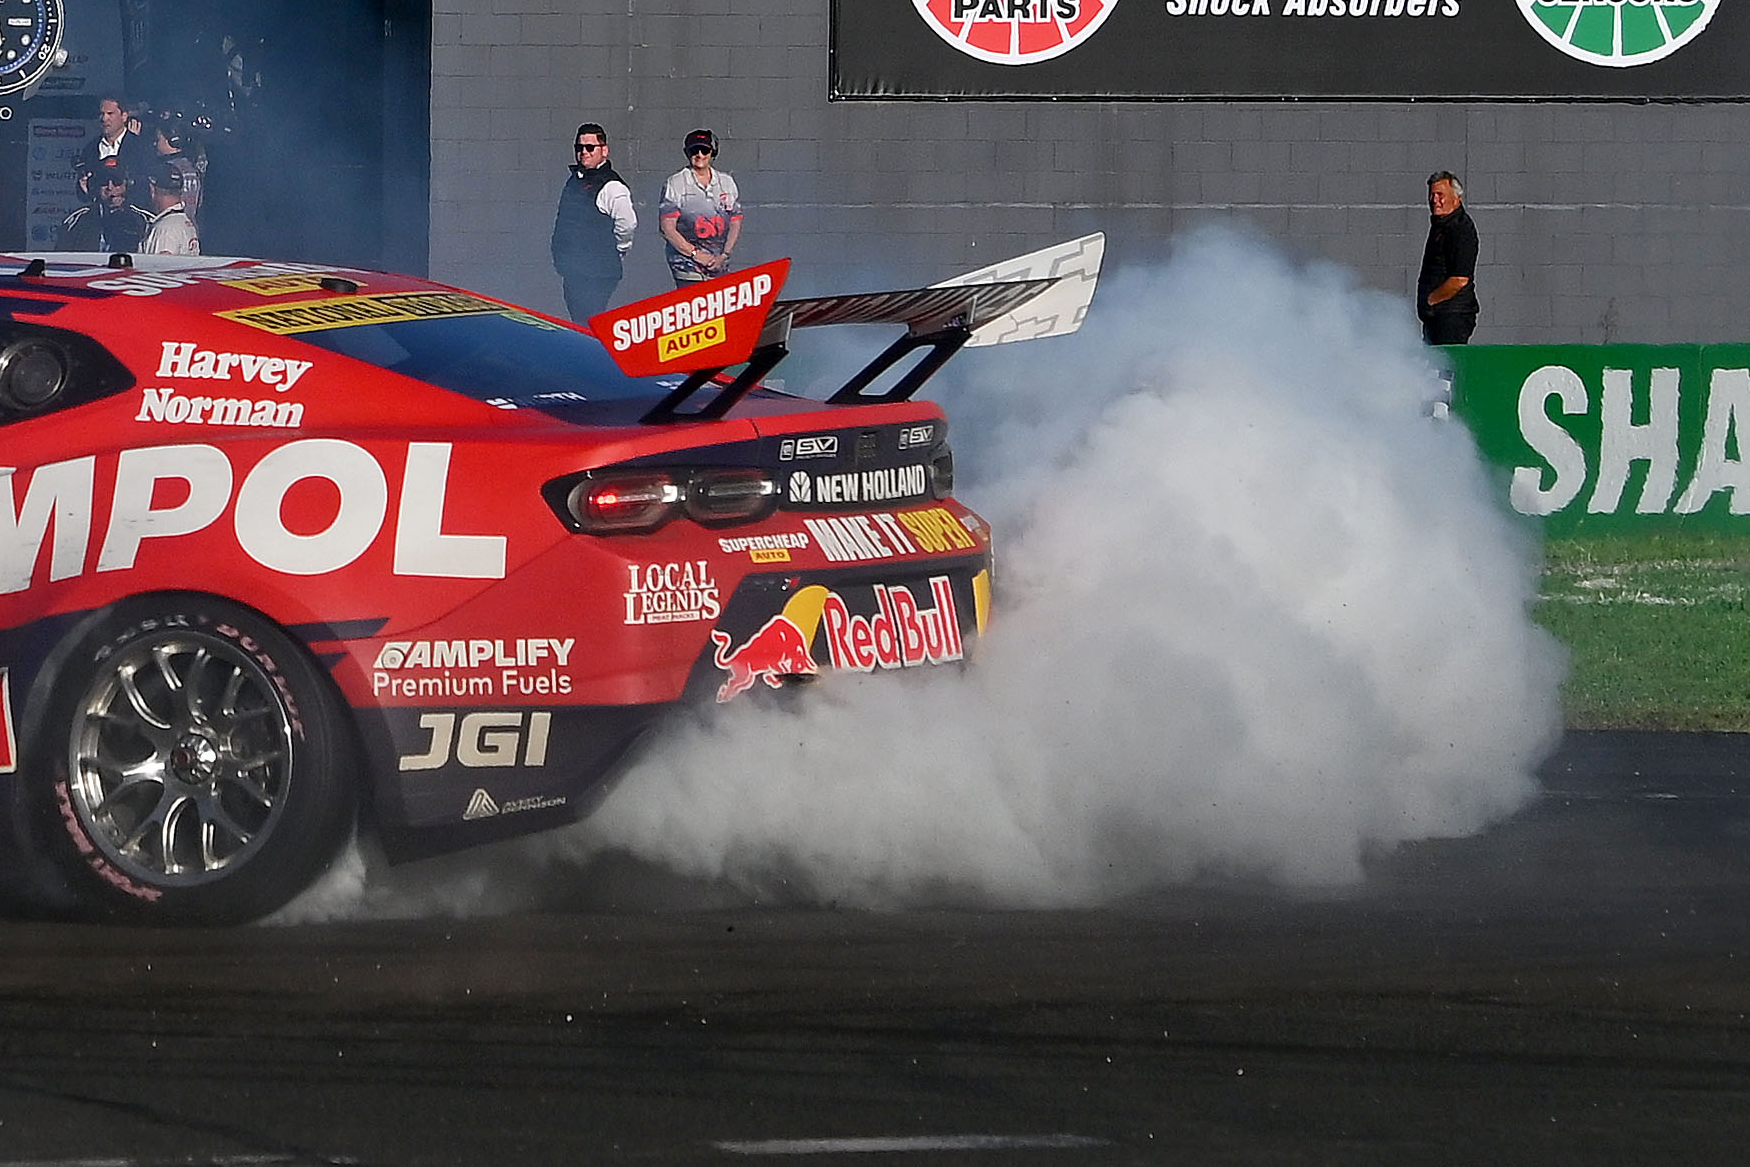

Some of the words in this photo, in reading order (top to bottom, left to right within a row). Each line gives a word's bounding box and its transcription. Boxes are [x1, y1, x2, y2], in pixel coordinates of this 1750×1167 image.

[611, 272, 774, 352] SUPERCHEAP
[665, 324, 718, 356] AUTO
[155, 341, 314, 393] Harvey
[134, 387, 305, 429] Norman
[798, 437, 838, 454] SV
[816, 473, 859, 503] NEW
[861, 464, 927, 501] HOLLAND
[718, 532, 810, 554] SUPERCHEAP
[804, 515, 894, 562] MAKE
[873, 513, 917, 555] IT
[898, 508, 977, 553] SUPER
[627, 560, 716, 594] LOCAL
[623, 589, 722, 625] LEGENDS
[406, 638, 575, 668] AMPLIFY
[373, 670, 493, 699] Premium
[502, 670, 573, 696] Fuels
[399, 712, 552, 771] JGI
